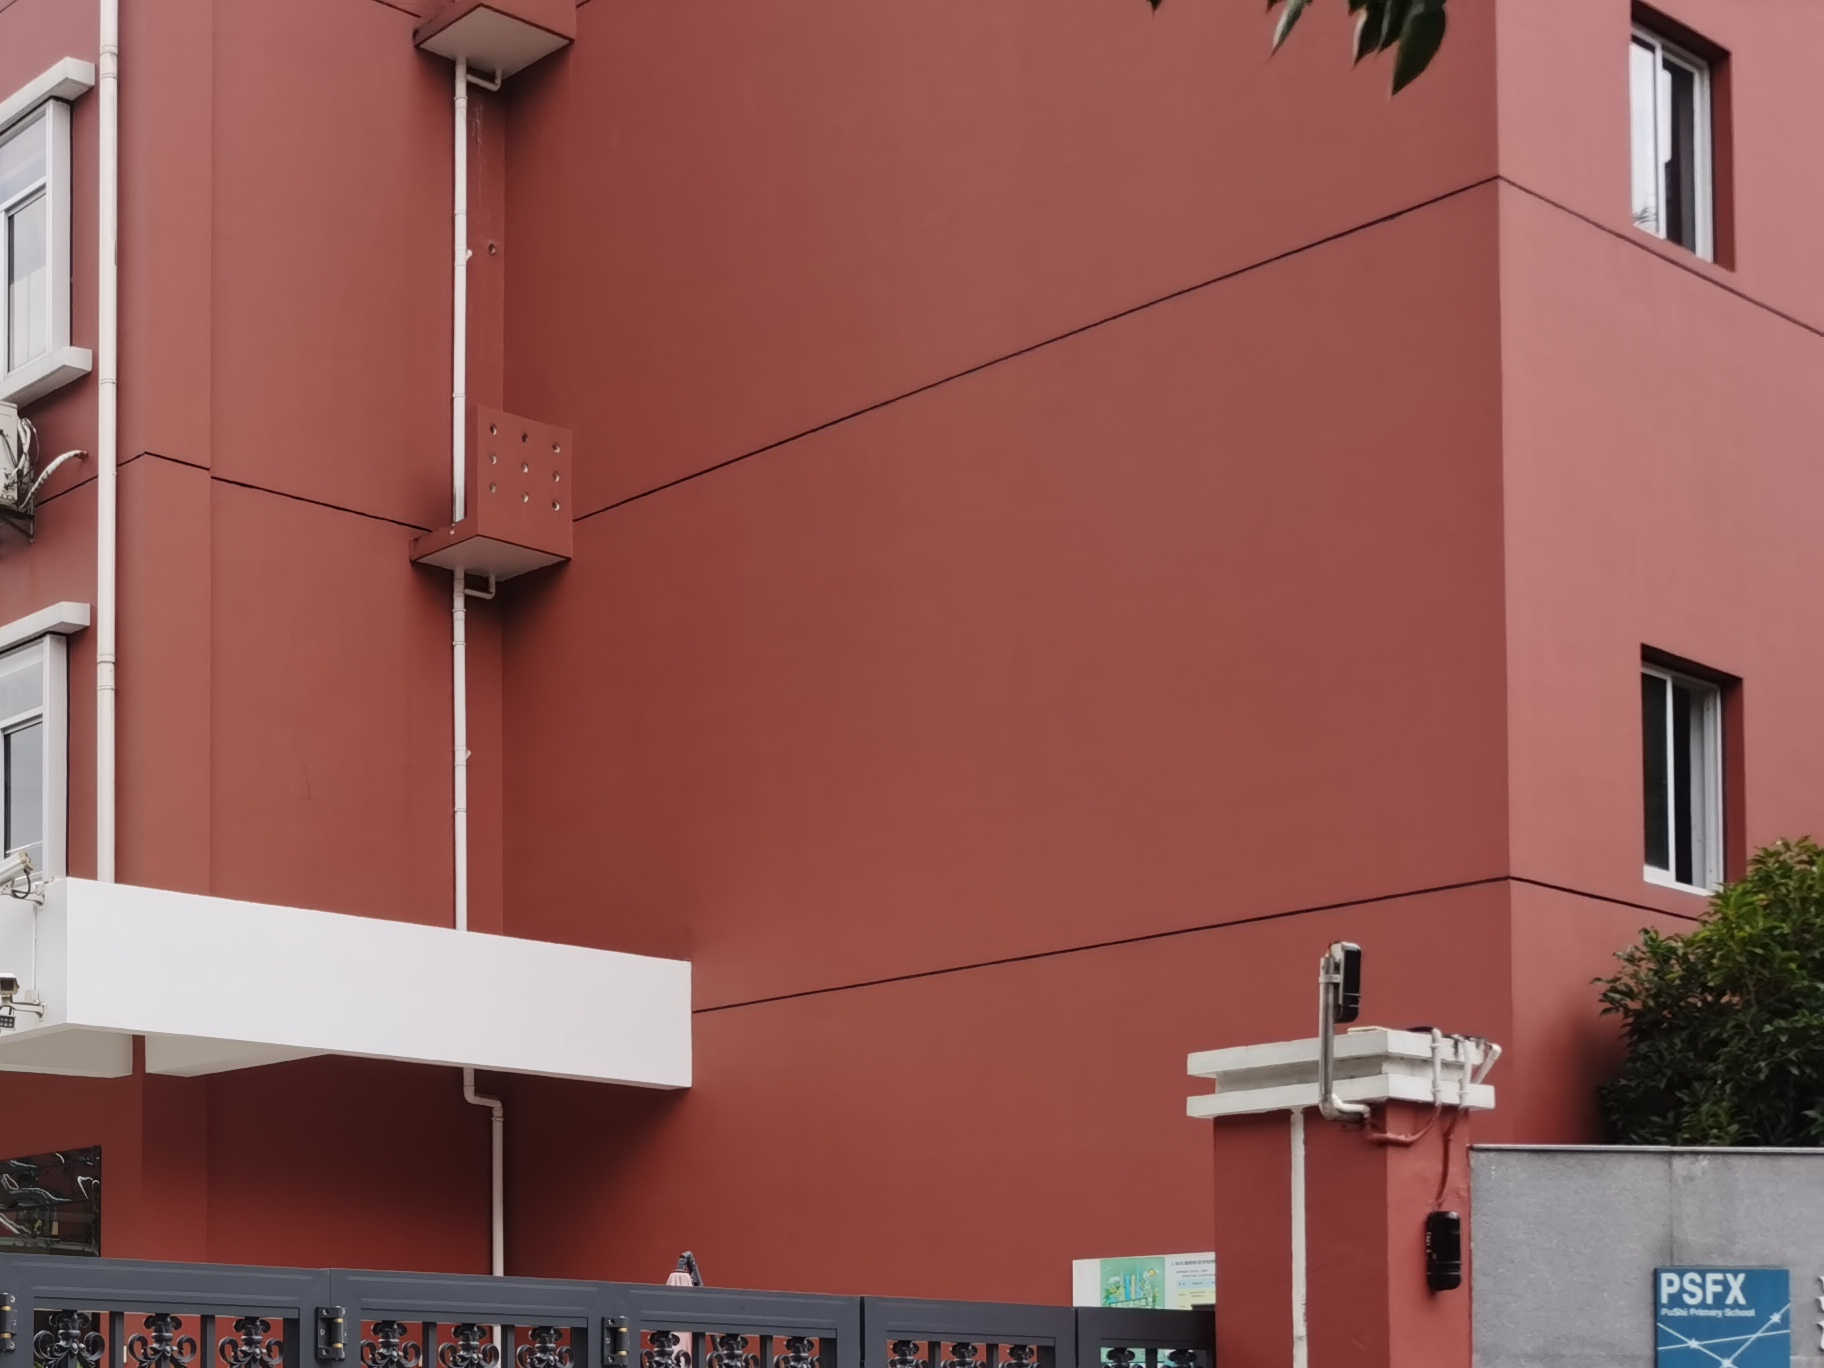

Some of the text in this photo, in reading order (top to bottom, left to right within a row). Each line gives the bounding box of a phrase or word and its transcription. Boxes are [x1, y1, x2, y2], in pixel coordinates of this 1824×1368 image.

[1660, 1272, 1747, 1305] PSFX
[1689, 1307, 1723, 1318] Primary
[1724, 1308, 1756, 1317] School
